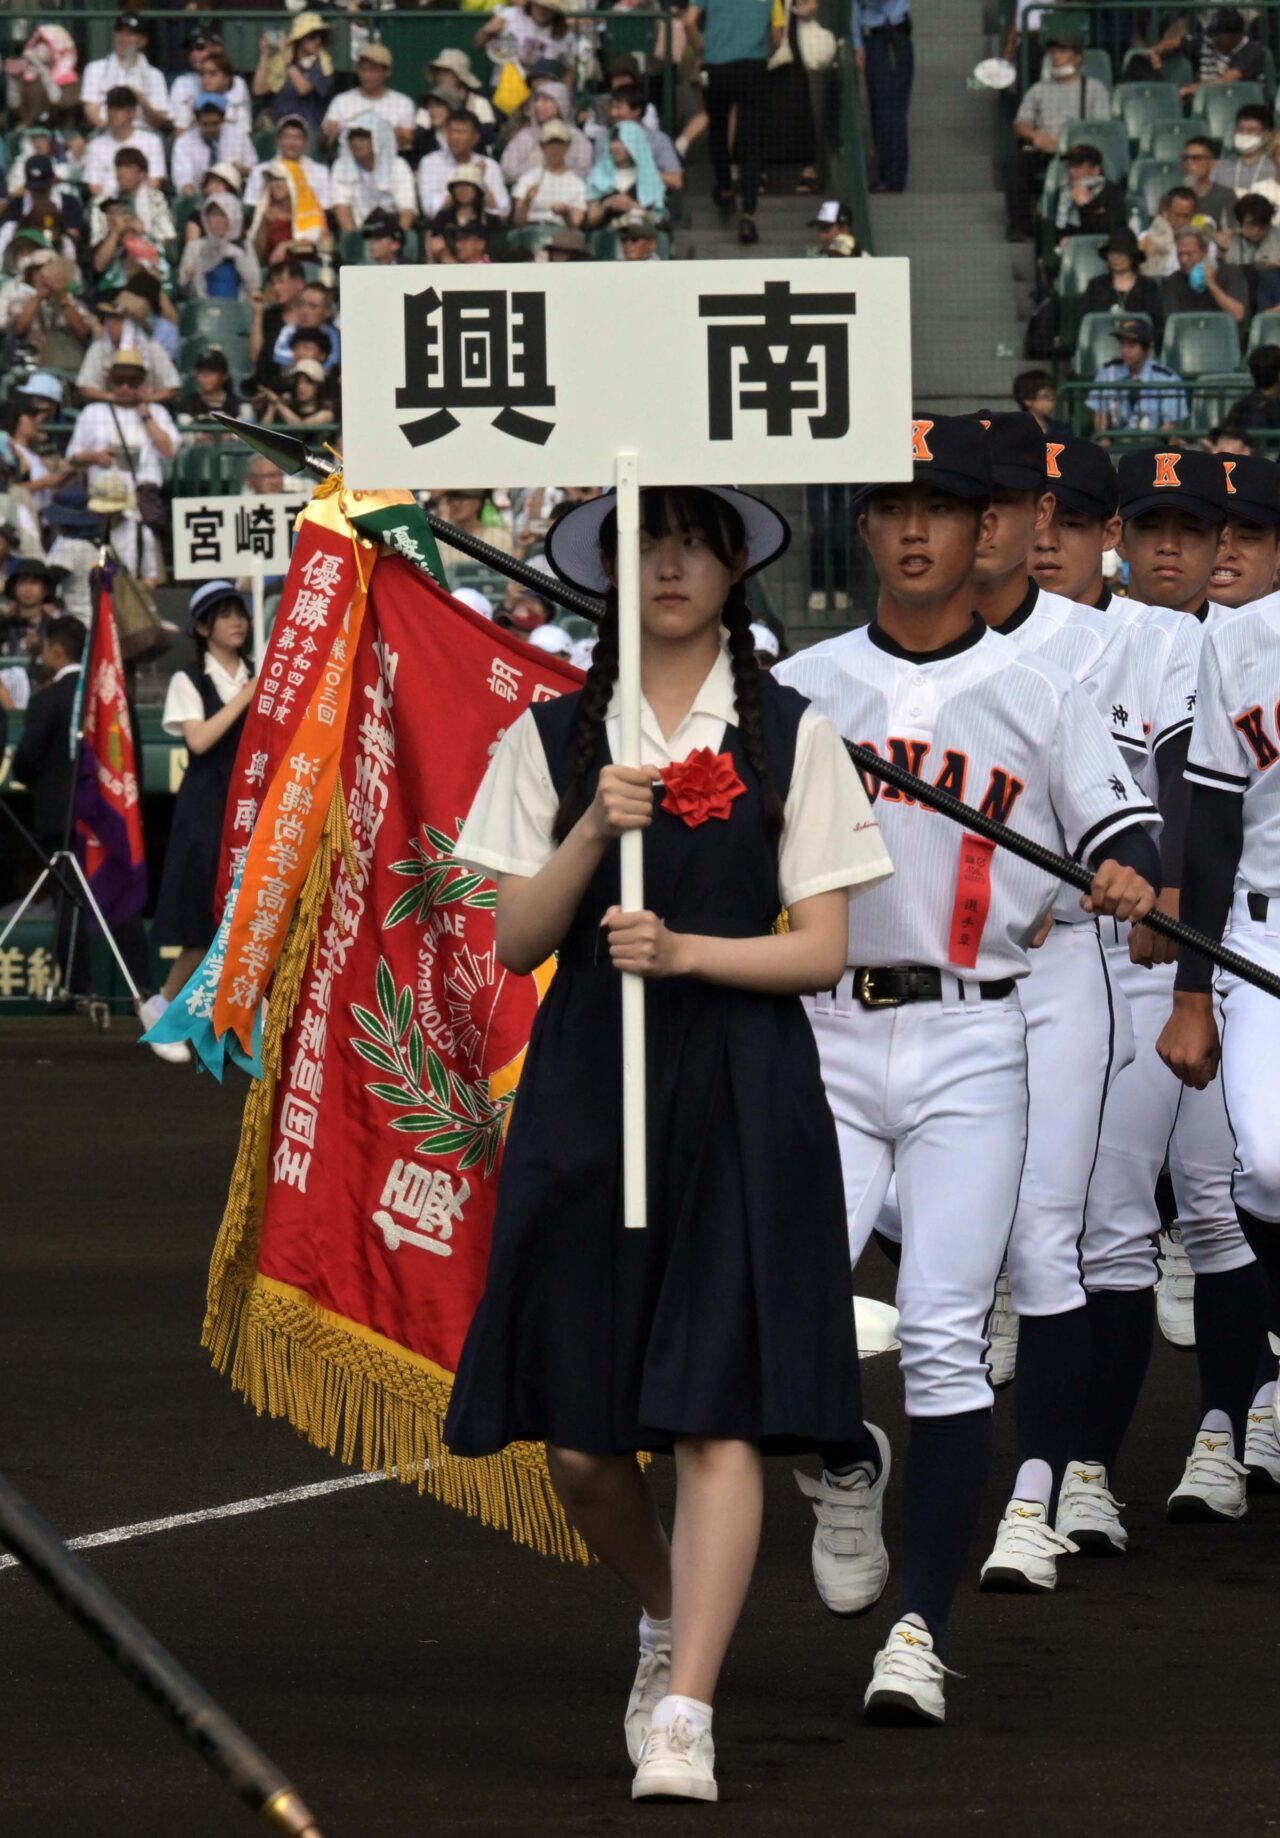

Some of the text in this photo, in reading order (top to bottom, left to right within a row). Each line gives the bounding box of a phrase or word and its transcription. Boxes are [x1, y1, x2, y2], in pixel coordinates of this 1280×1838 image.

[912, 420, 934, 461] K
[1153, 453, 1182, 487] K
[185, 503, 307, 564] 宮崎
[288, 549, 345, 632] 優勝
[272, 634, 318, 726] 令和四年度
[856, 736, 1025, 824] ONAN
[417, 947, 457, 1058] CTORIBUS
[371, 1158, 472, 1258] 優
